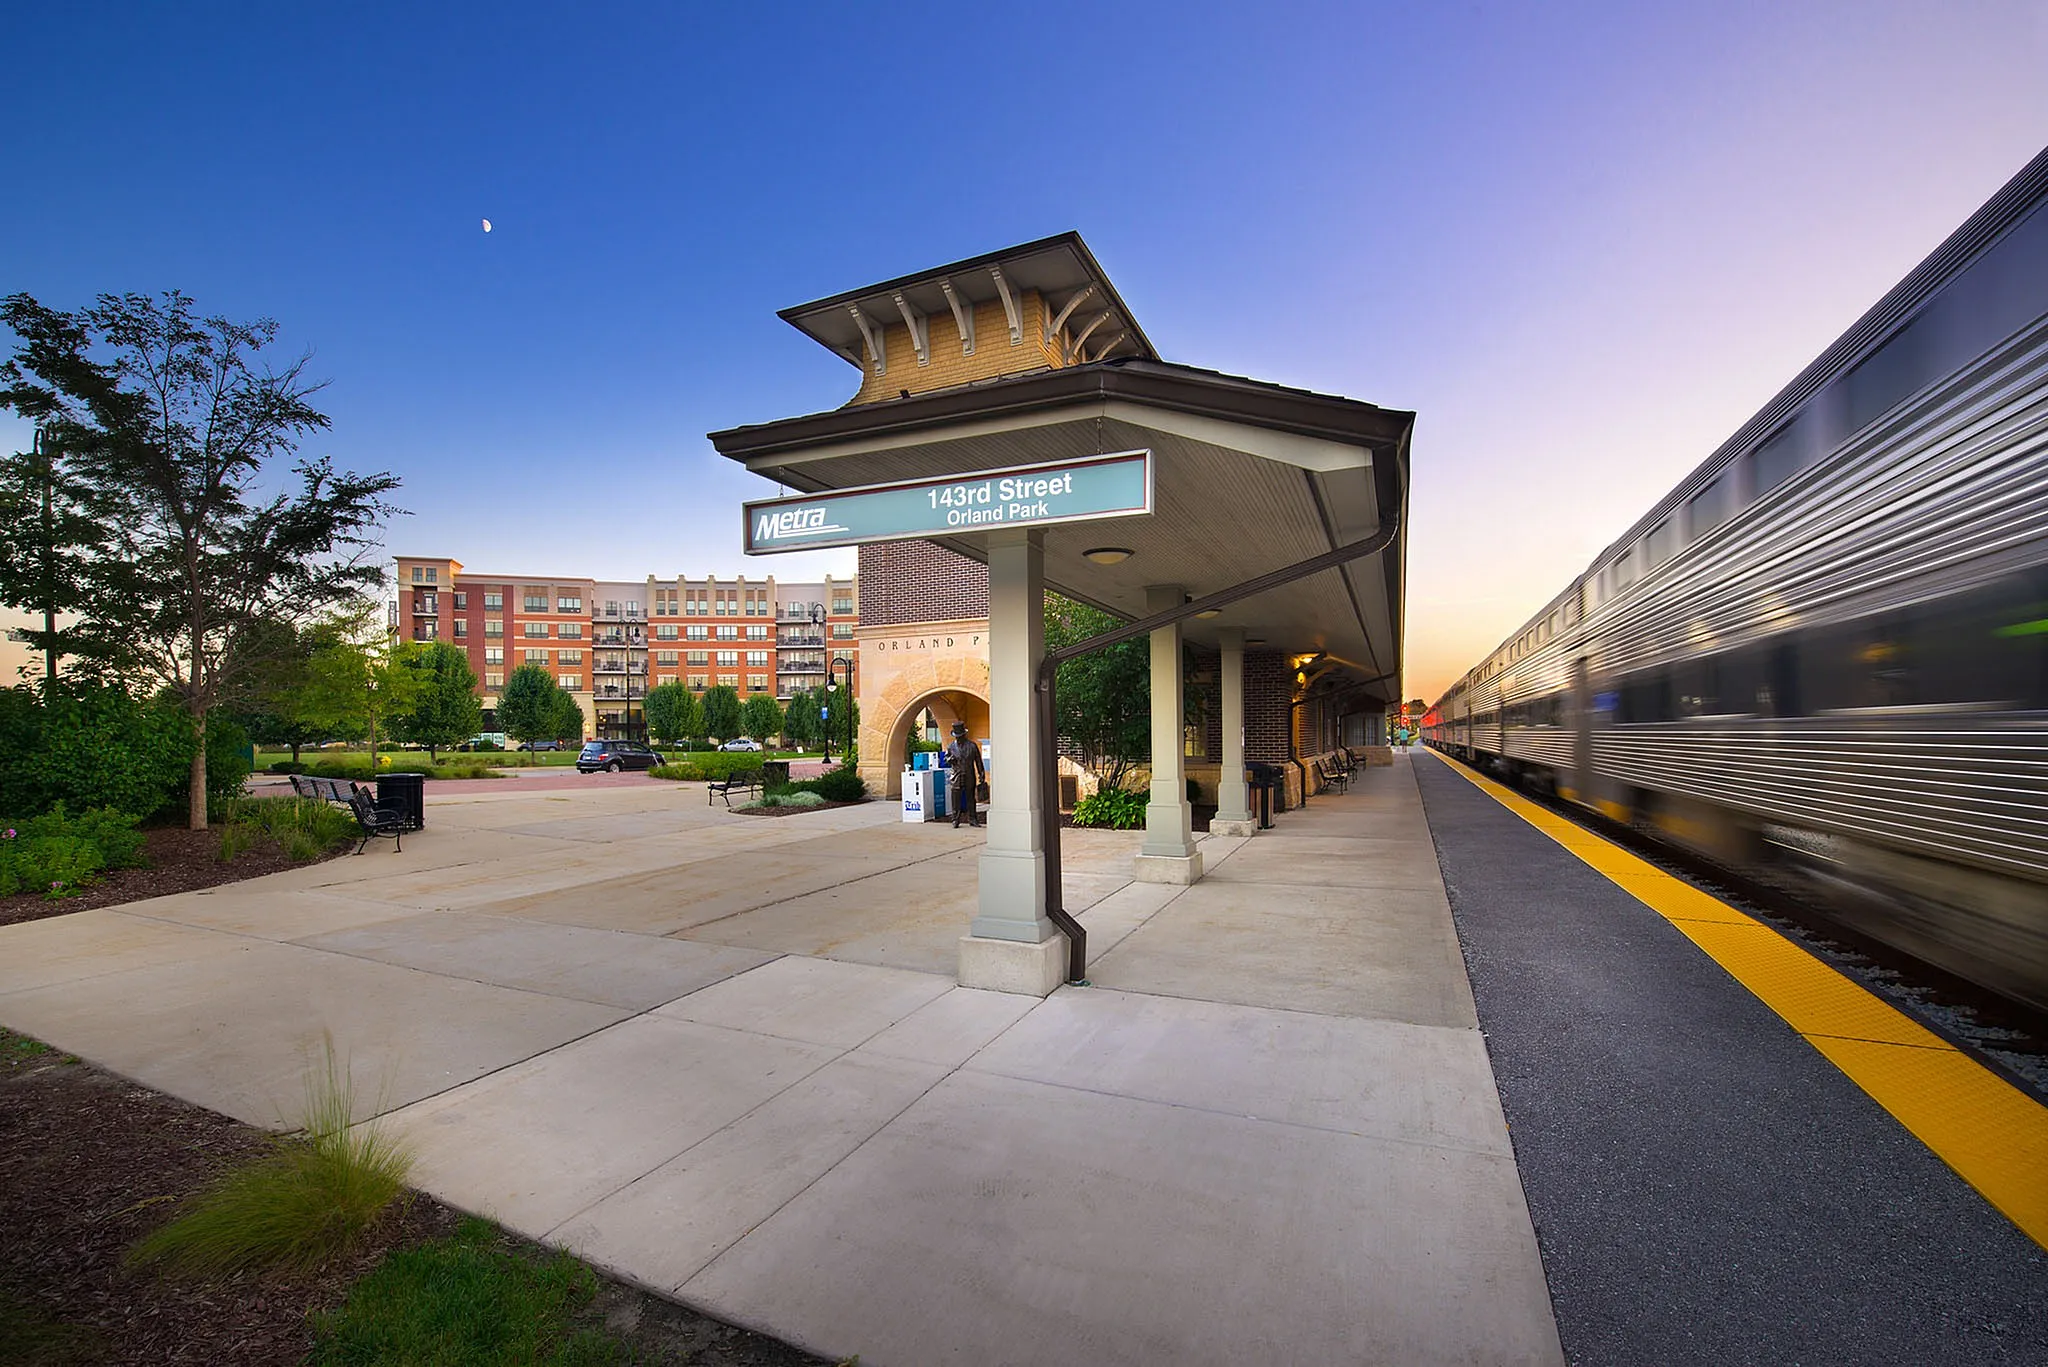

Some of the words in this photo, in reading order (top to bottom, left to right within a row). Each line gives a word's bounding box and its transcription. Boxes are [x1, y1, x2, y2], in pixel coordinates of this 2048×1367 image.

[928, 482, 991, 509] 143rd
[999, 472, 1073, 501] Street
[755, 508, 827, 541] Metra
[947, 505, 1003, 526] Orland
[1009, 500, 1049, 519] Park
[878, 637, 954, 651] ORLAND
